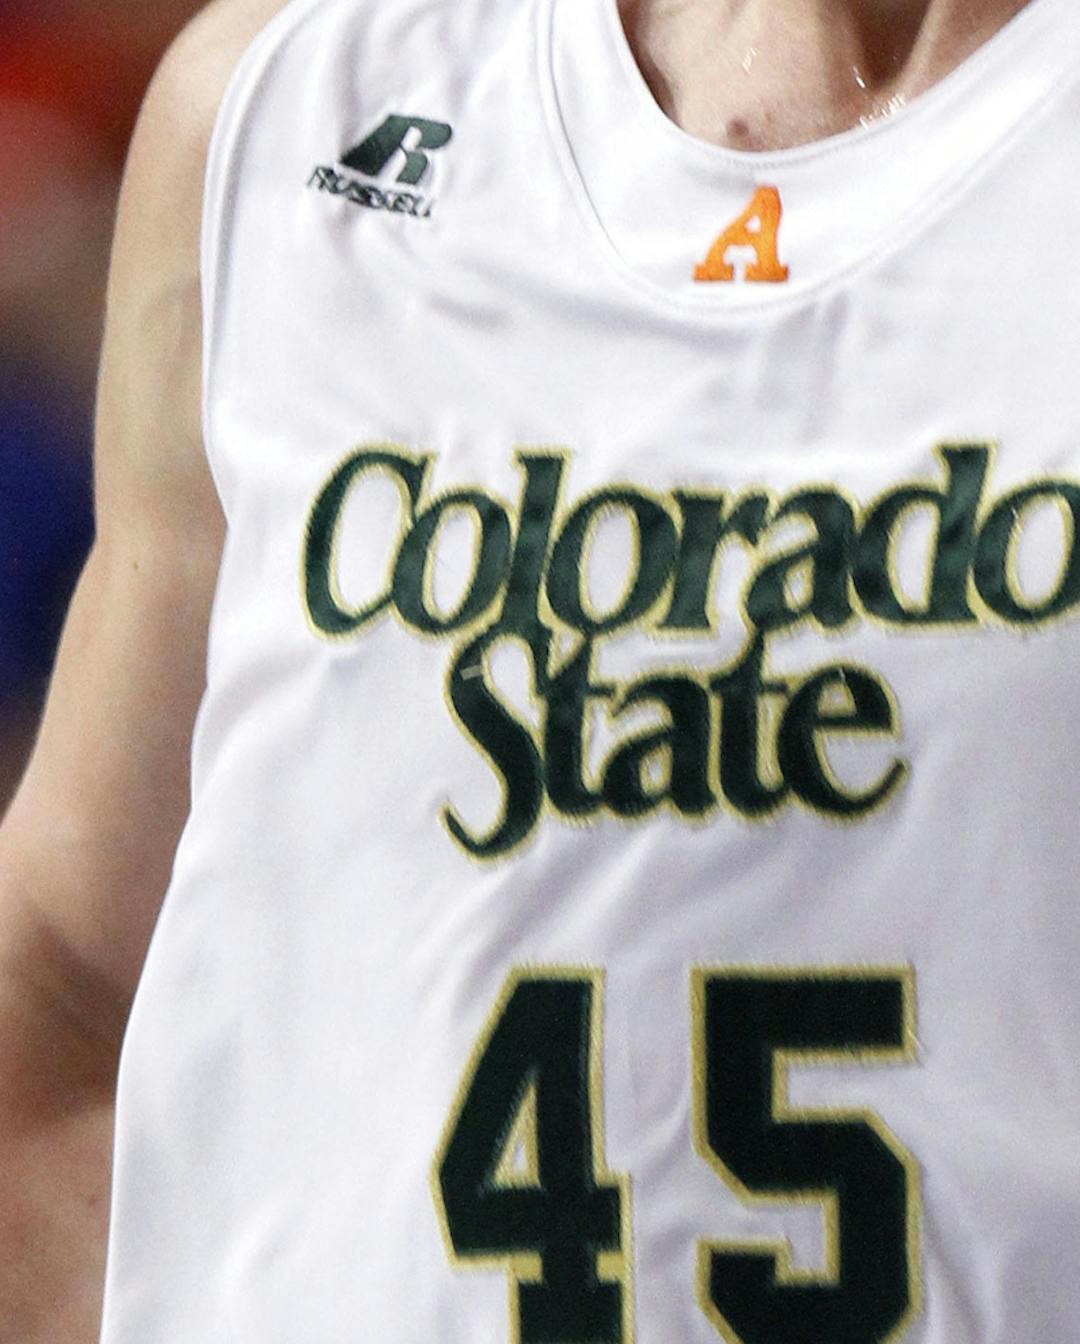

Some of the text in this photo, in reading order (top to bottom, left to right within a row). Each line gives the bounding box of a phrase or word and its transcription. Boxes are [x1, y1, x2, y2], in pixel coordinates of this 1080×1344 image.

[341, 113, 453, 185] R
[692, 184, 789, 282] A
[438, 621, 912, 859] State
[430, 964, 922, 1344] 45
